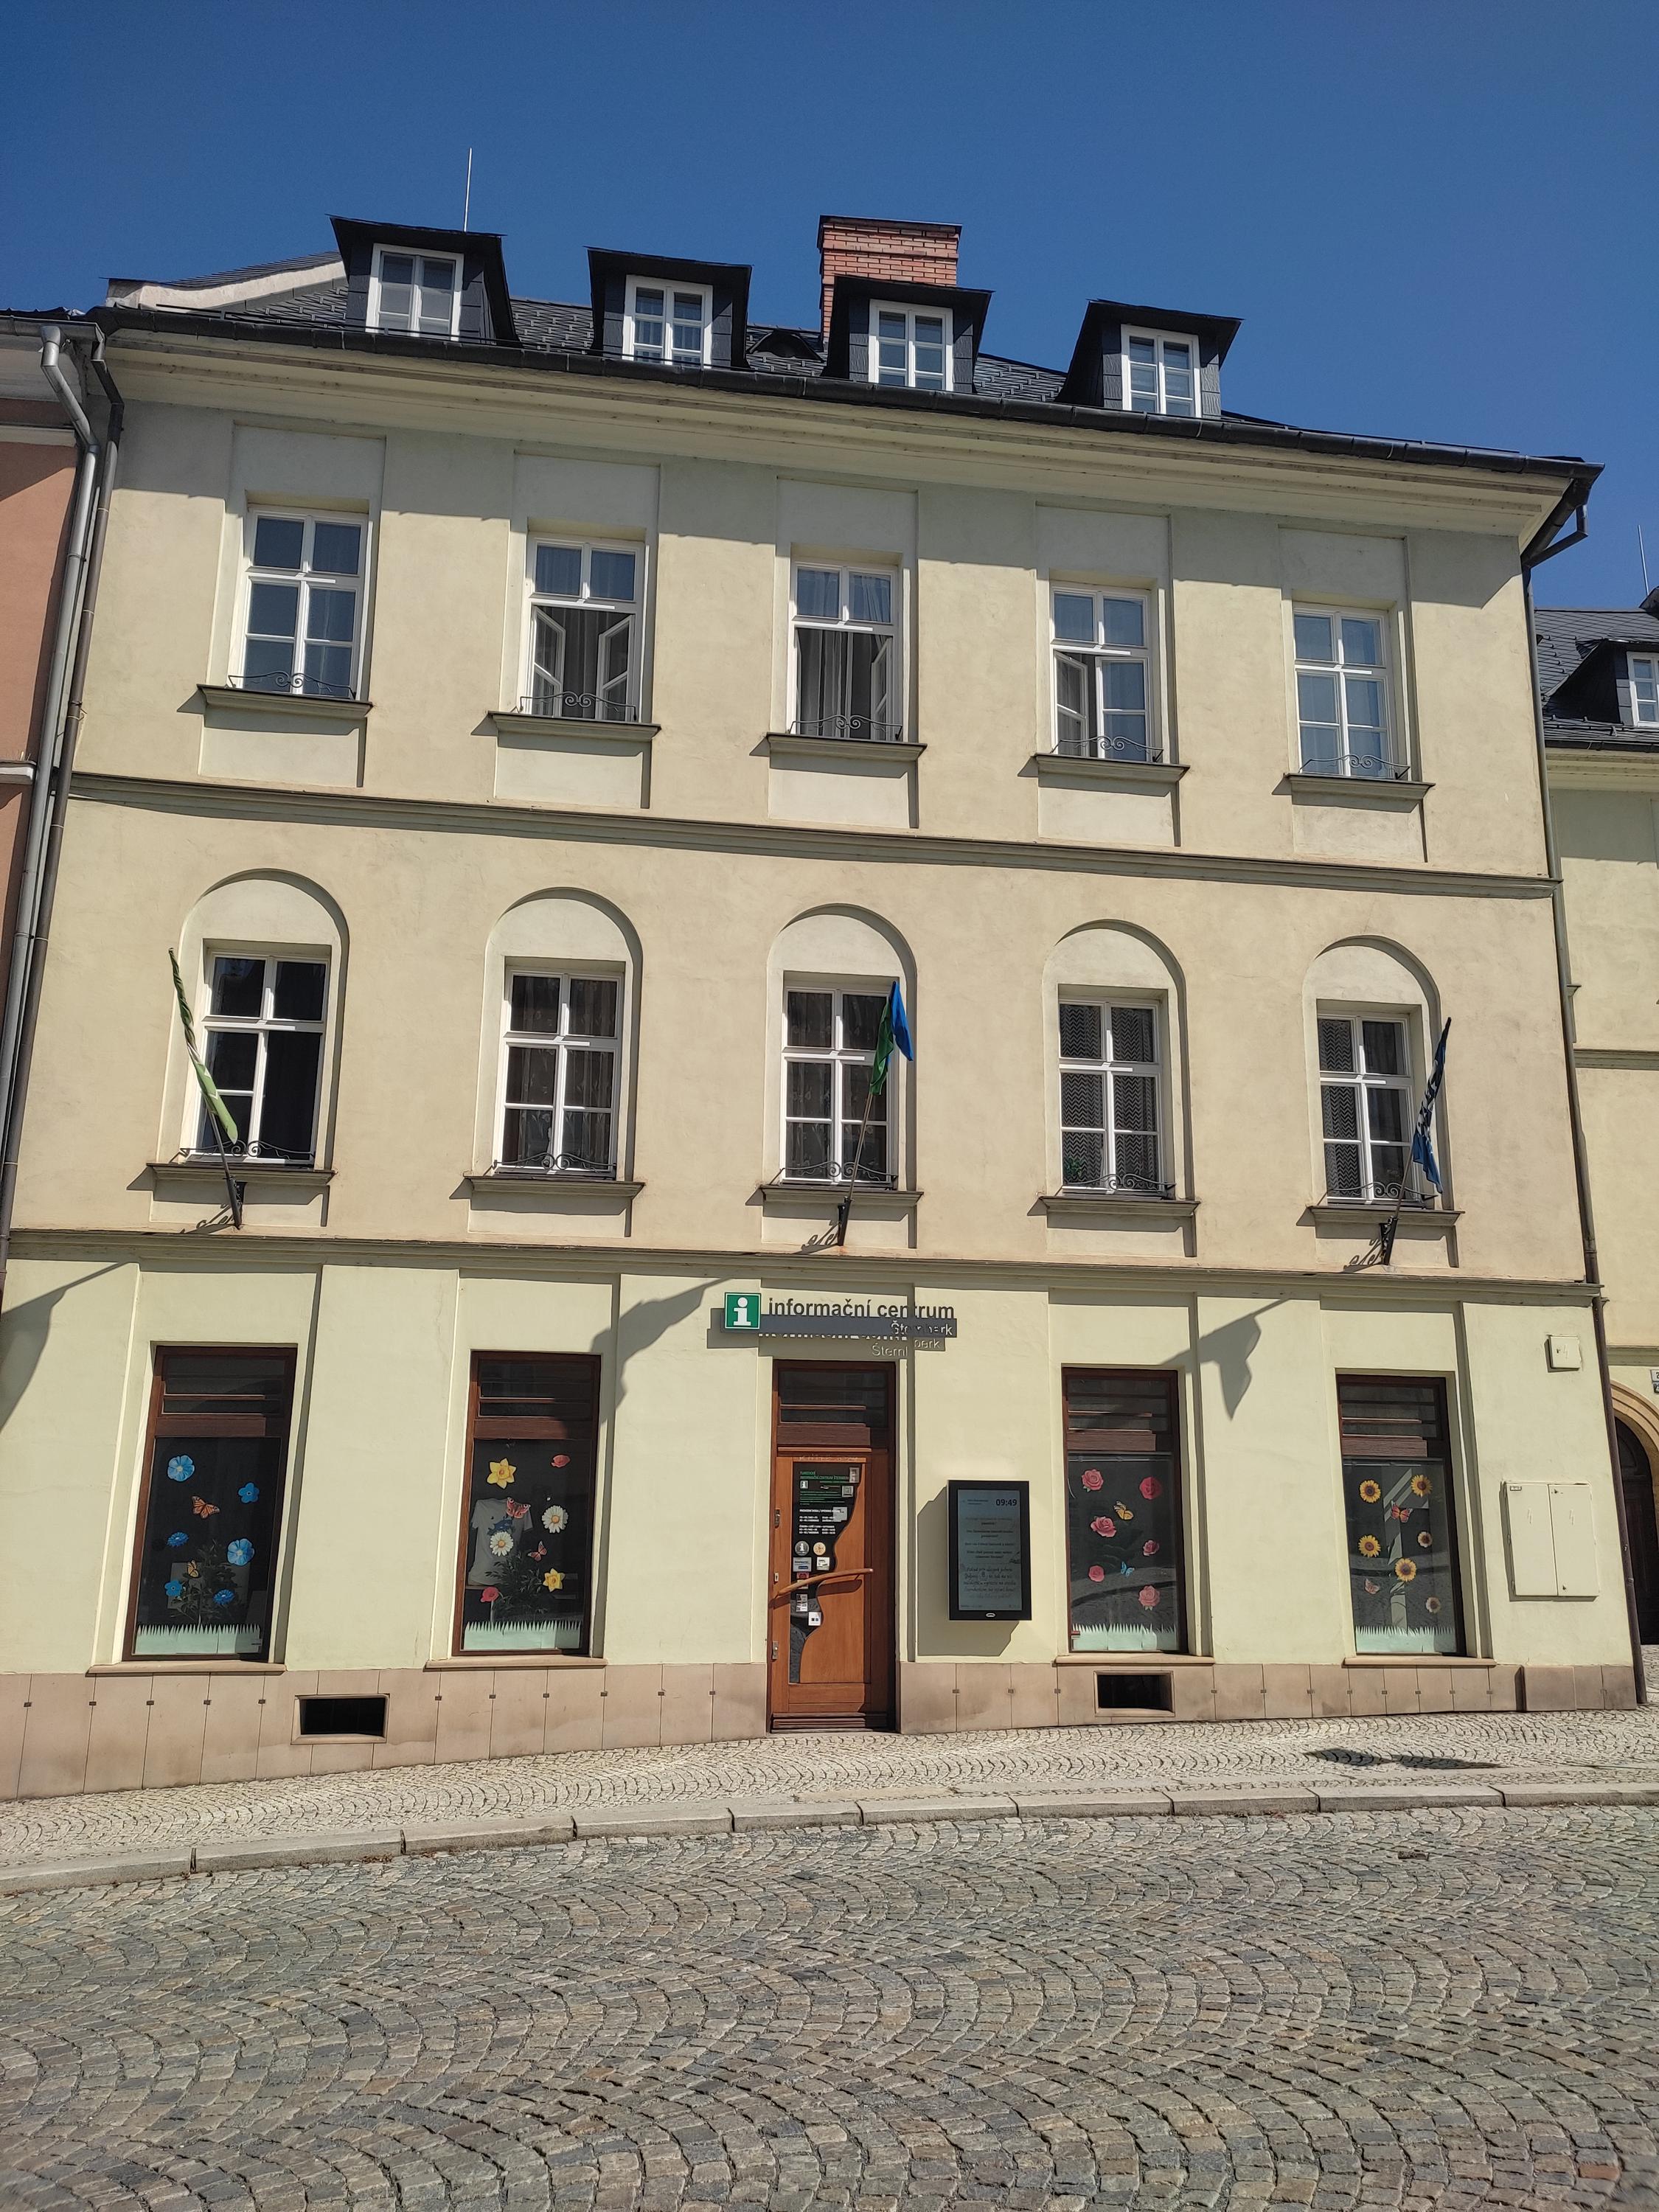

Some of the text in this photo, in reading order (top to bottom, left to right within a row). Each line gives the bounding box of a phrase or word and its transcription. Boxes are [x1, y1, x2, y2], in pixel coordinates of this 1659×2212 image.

[769, 1298, 954, 1319] informační centrum
[891, 1320, 953, 1335] Šterberk
